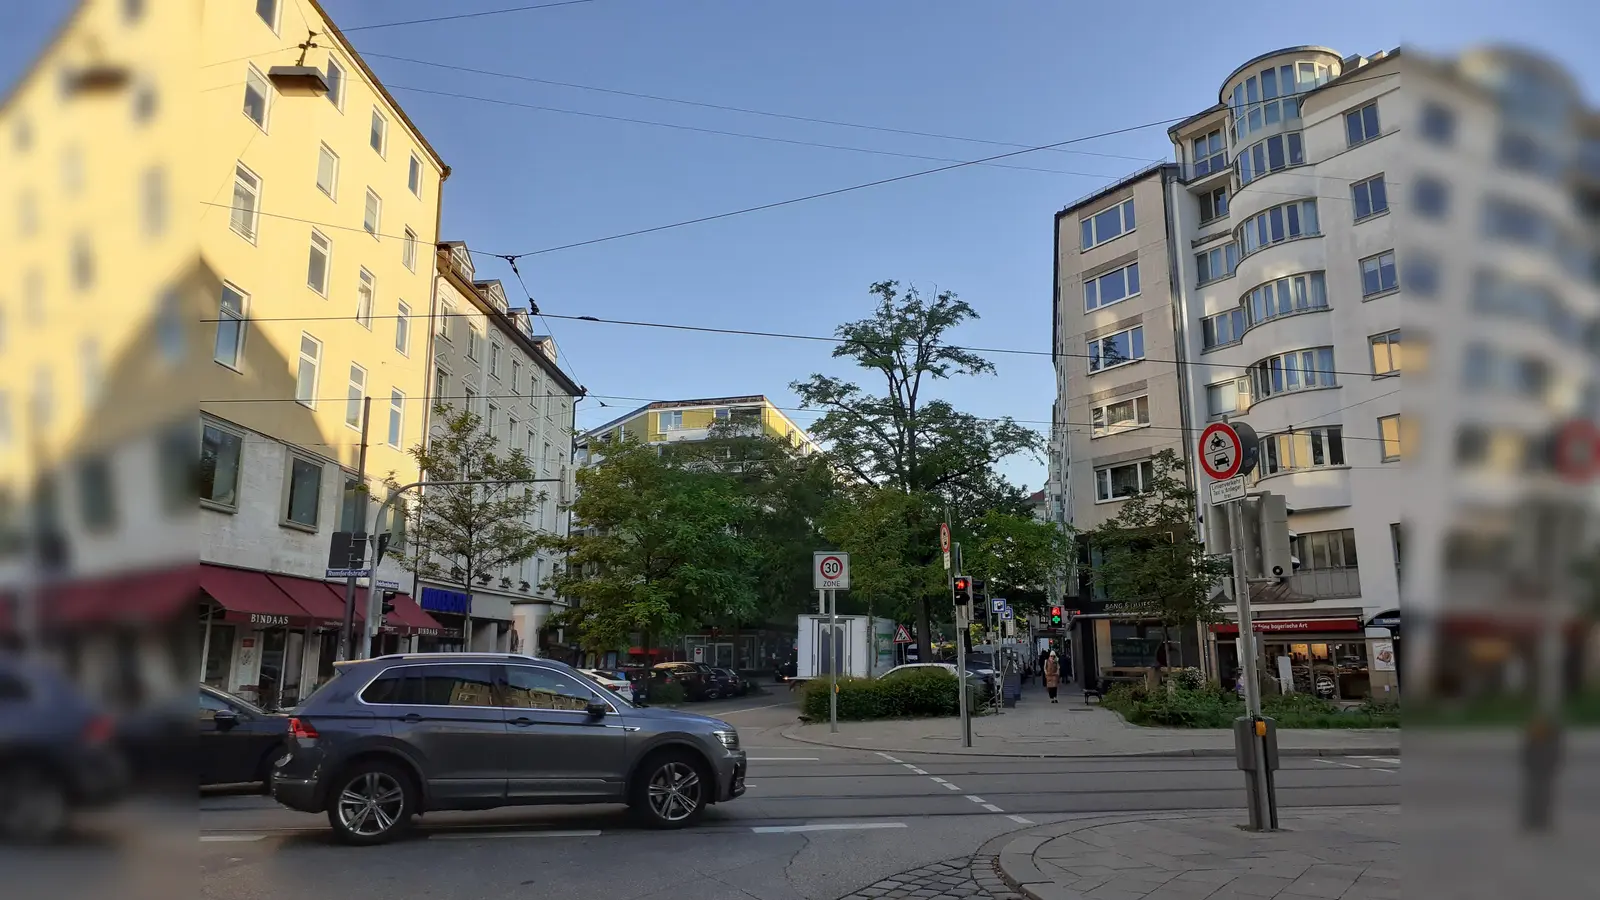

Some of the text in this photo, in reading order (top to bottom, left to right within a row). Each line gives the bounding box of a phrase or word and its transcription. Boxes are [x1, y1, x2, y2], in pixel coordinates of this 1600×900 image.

[824, 562, 839, 574] 30
[1105, 602, 1123, 610] BANG
[250, 613, 289, 625] BINDAAS
[417, 627, 438, 636] BINDAAS
